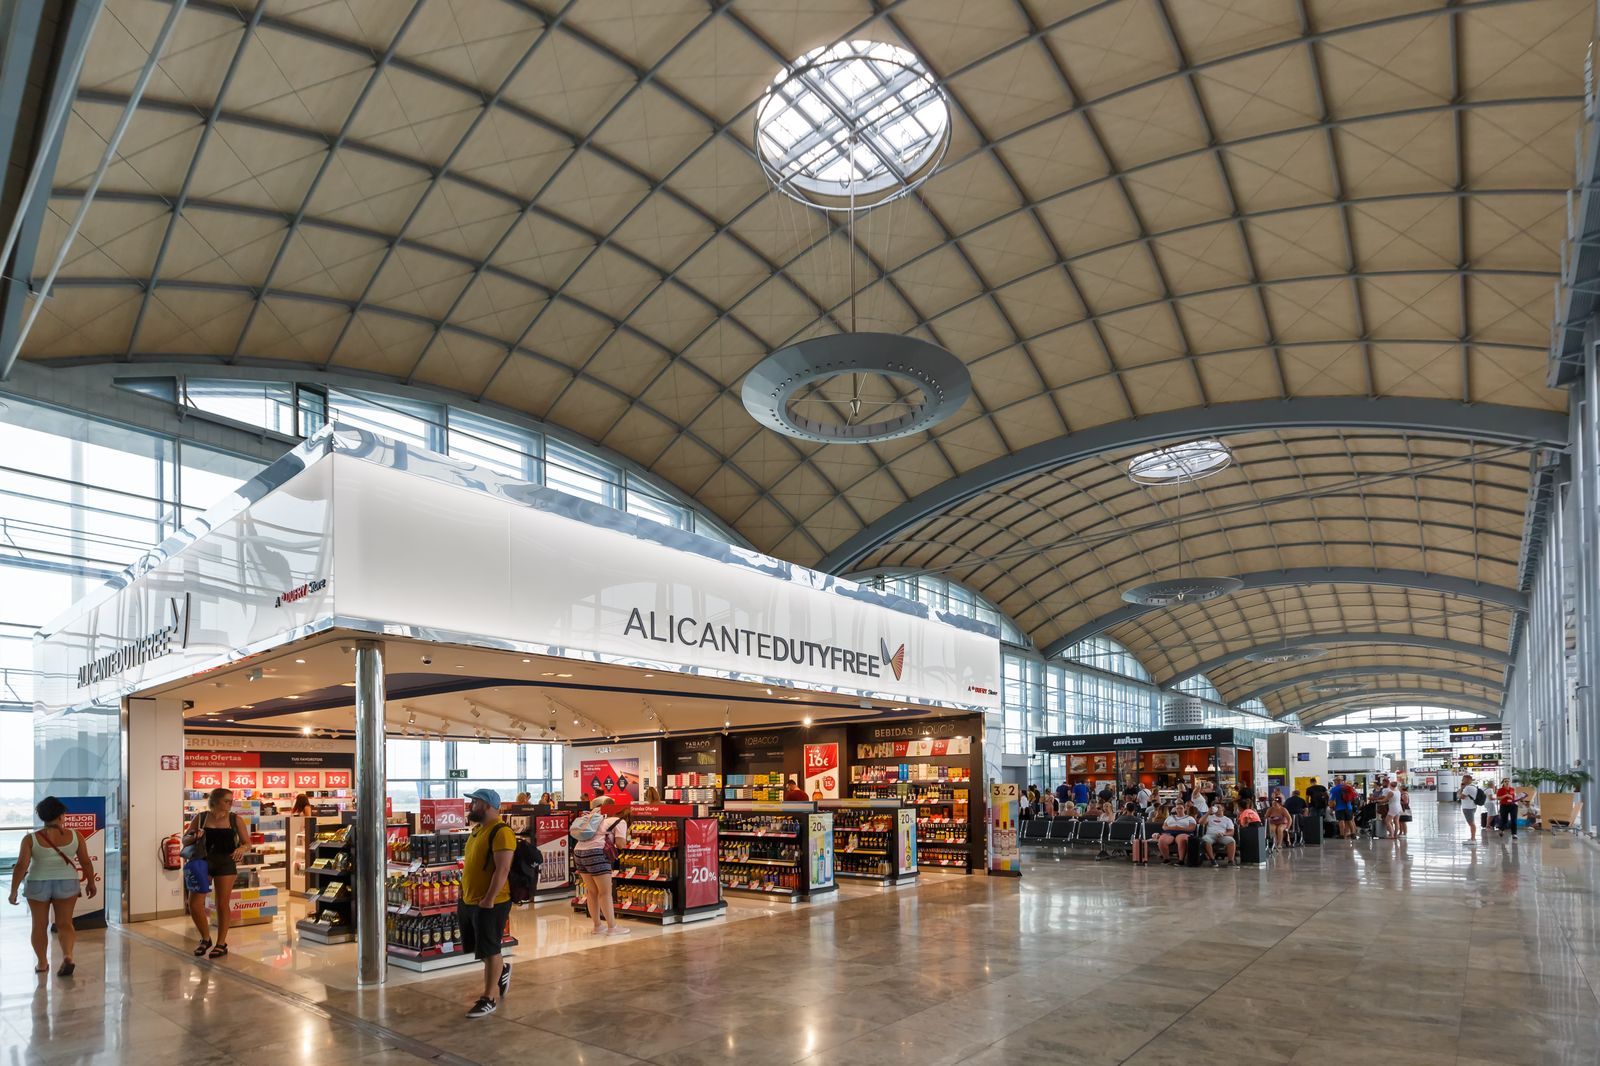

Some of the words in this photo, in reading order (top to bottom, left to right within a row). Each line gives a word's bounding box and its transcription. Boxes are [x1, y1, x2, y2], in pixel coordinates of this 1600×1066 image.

[624, 607, 880, 678] ALICANTEDUTYFREE
[77, 625, 173, 689] ALICANTEDUTYFREE
[874, 727, 913, 738] BEBIDAS
[1173, 733, 1212, 742] SANDWICHES
[186, 737, 254, 748] ERFUMERÍA
[1113, 736, 1143, 745] LAVAZZA
[210, 754, 242, 762] Ofertas
[195, 776, 221, 785] -40%
[231, 776, 255, 785] -40%
[993, 785, 1001, 796] 3
[1008, 785, 1015, 796] 2
[421, 814, 434, 825] -20%
[438, 813, 463, 824] -20%
[810, 822, 827, 832] -20%
[687, 866, 717, 884] -20%
[234, 901, 268, 910] Summer
